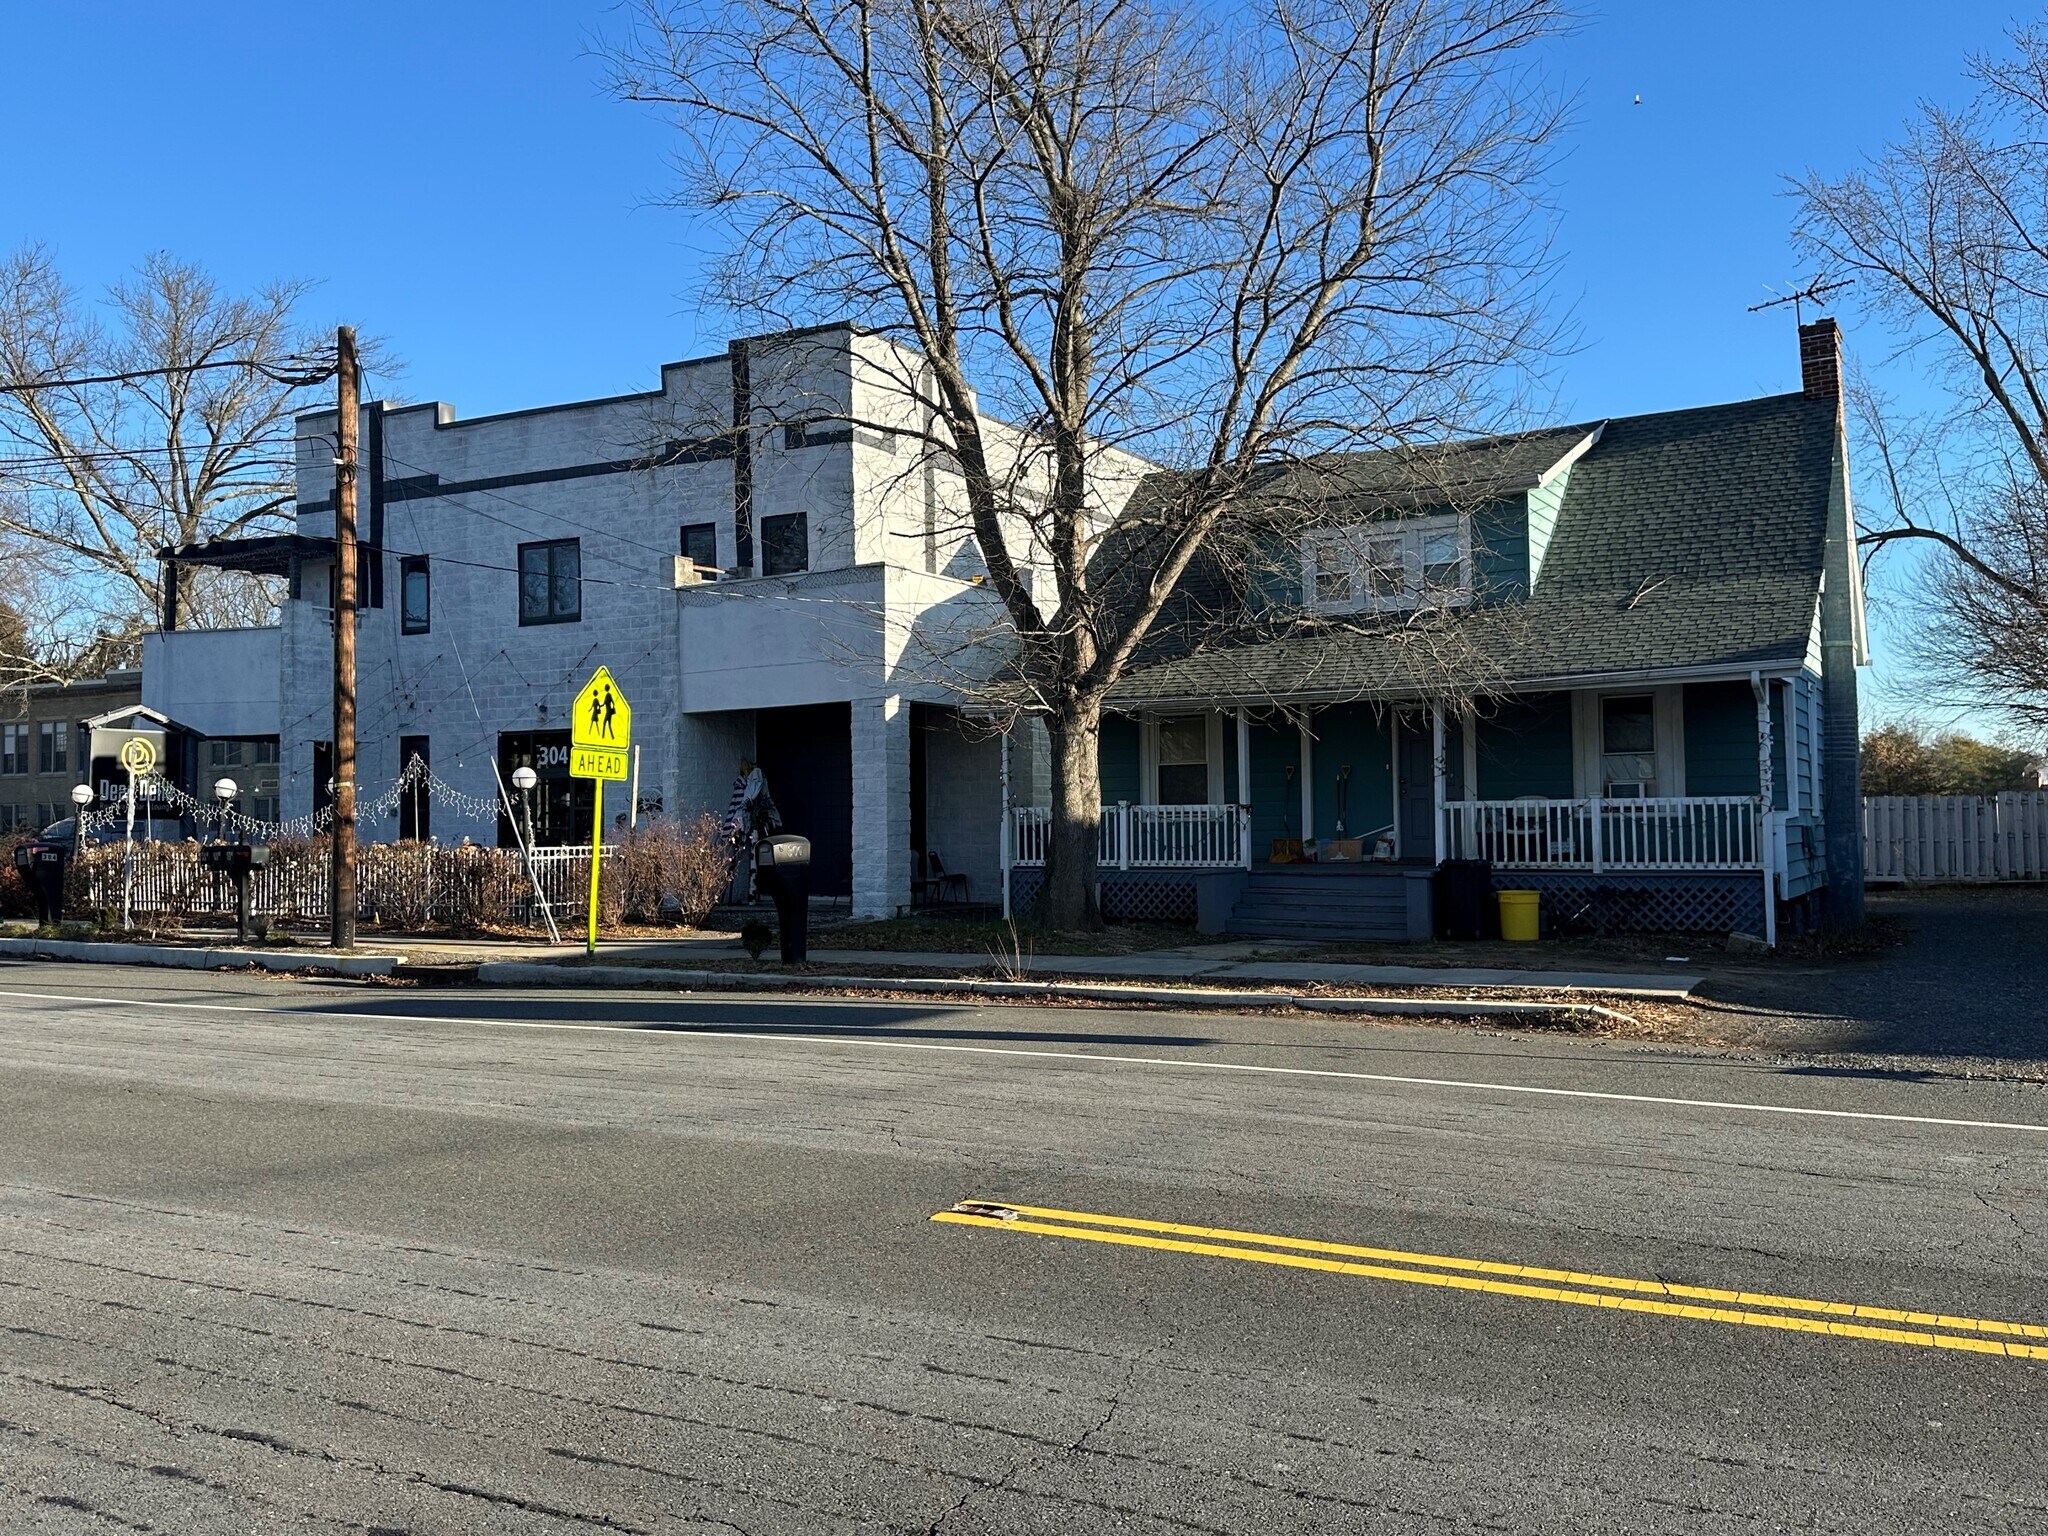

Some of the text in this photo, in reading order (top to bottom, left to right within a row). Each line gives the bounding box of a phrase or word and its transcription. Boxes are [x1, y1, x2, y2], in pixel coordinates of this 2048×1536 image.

[539, 745, 569, 765] 304
[578, 754, 621, 774] AHEAD
[100, 779, 132, 801] Dea
[151, 802, 172, 813] Loung
